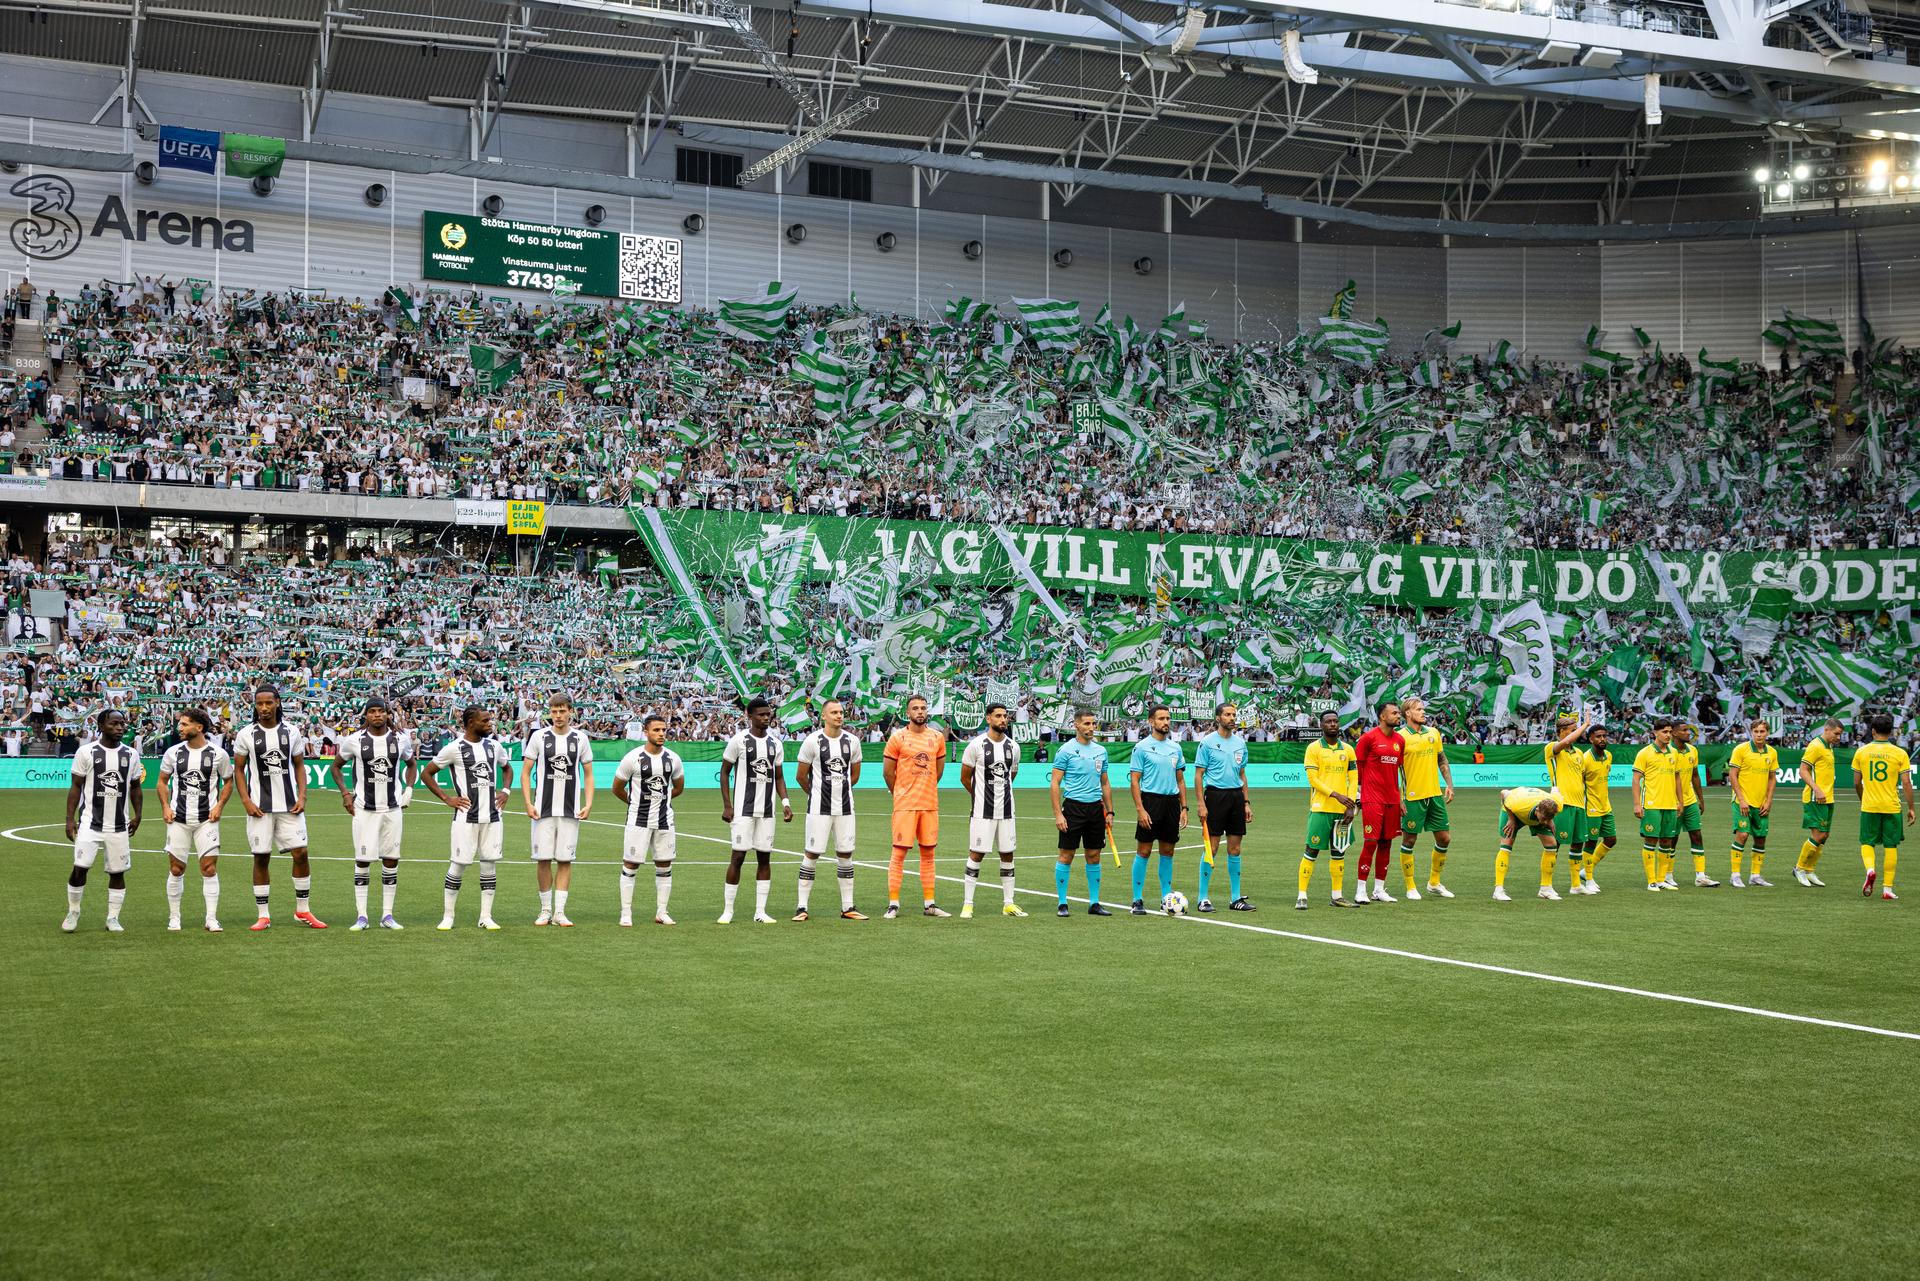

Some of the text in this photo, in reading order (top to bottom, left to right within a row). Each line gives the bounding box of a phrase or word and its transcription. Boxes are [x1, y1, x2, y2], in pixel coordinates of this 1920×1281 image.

[162, 140, 213, 160] UEFA
[243, 154, 279, 163] RESPECT
[90, 195, 255, 253] Arena
[481, 217, 510, 229] Stötta
[512, 222, 562, 236] Hammarby
[563, 227, 601, 240] Ungdom
[507, 233, 583, 250] Köp 50 50 lotter!
[432, 253, 475, 264] HAMMARBY
[439, 260, 468, 271] FOTBOLL
[502, 256, 587, 273] Vinstsumma just nu:
[16, 358, 41, 369] B308
[1076, 402, 1101, 418] BAJE
[512, 503, 540, 512] BAJEN
[512, 512, 534, 520] CLUB
[1013, 533, 1131, 586] VILL
[1146, 543, 1288, 590] LEVA
[1554, 552, 1637, 602] DÖ
[1654, 551, 1731, 602] PÅ
[1750, 552, 1920, 602] SÖDE
[394, 677, 416, 693] YATZY
[986, 692, 1018, 706] 1993
[26, 769, 67, 781] Convini
[1273, 772, 1300, 782] Convini
[1474, 773, 1499, 782] Convini
[1870, 760, 1888, 782] 18
